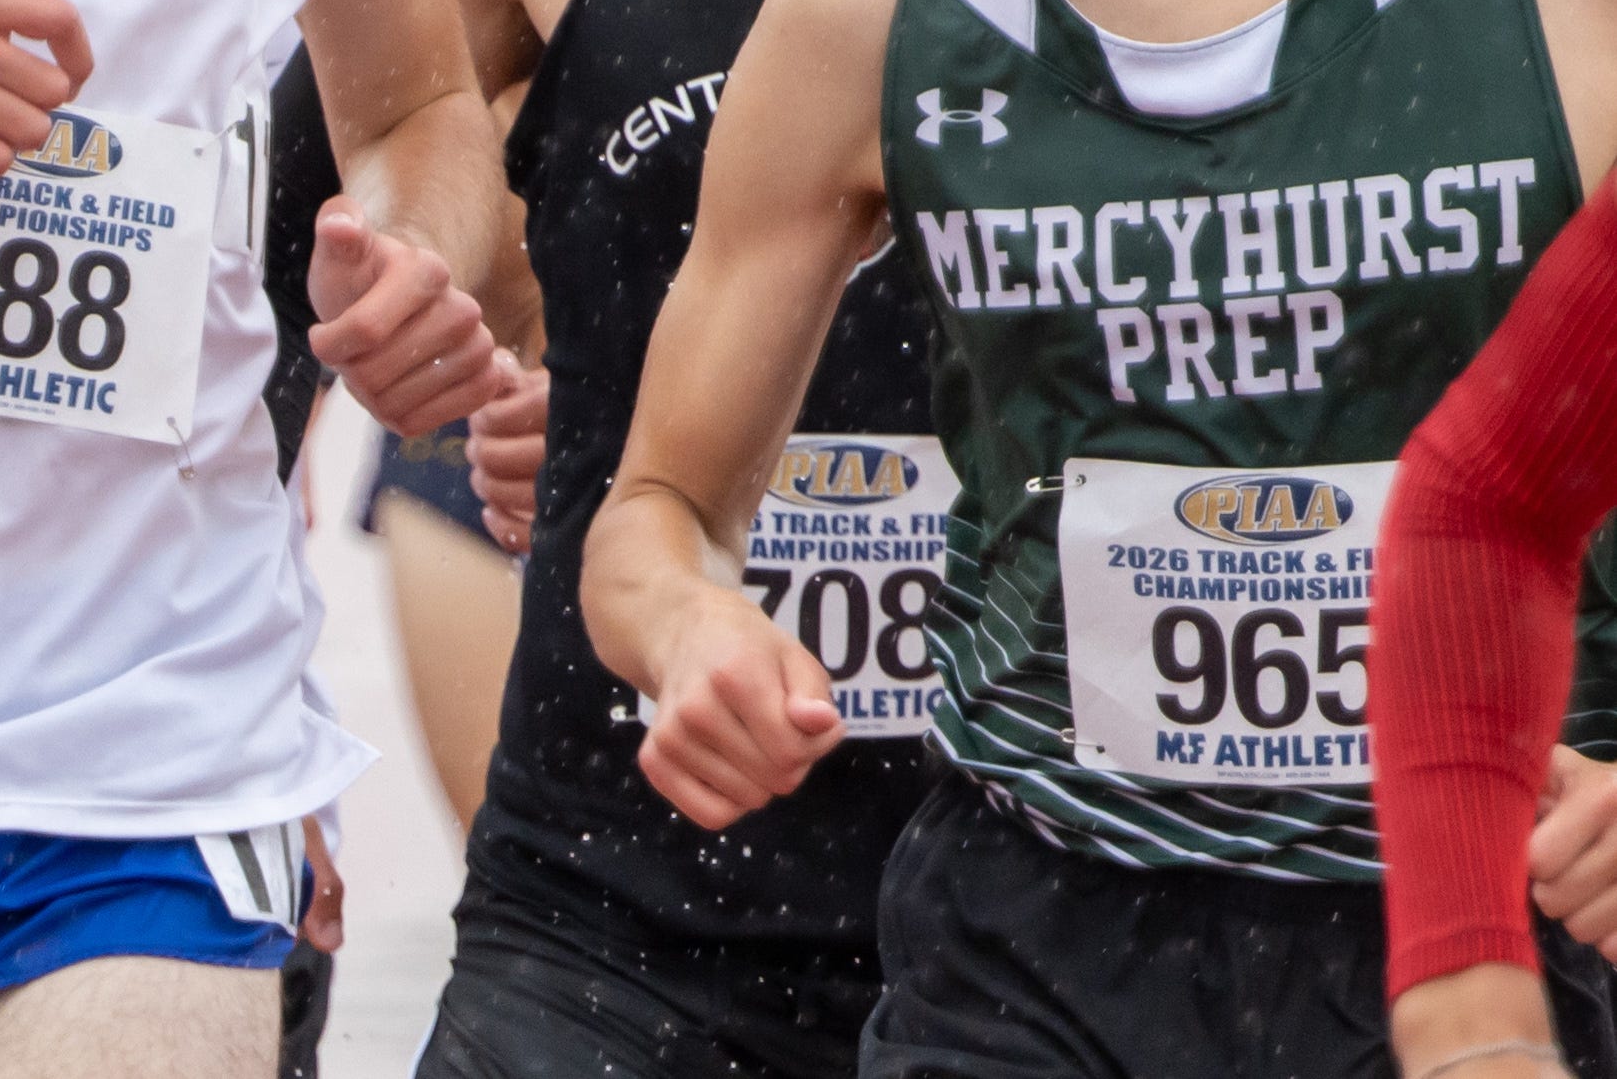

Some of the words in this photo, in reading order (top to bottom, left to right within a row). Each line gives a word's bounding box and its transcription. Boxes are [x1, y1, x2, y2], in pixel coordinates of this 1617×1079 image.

[605, 71, 726, 176] CENT
[85, 193, 101, 215] &
[107, 194, 176, 229] FIELD
[915, 158, 1536, 310] MERCYHURST
[1097, 289, 1345, 402] PREP
[776, 449, 909, 497] PIAA
[771, 512, 873, 536] TRACK
[881, 517, 902, 536] &
[1200, 483, 1343, 533] PIAA
[750, 537, 945, 562] AMPIONSHIP
[1107, 544, 1190, 573] 2026
[1197, 549, 1307, 575] TRACK
[1315, 552, 1338, 573] &
[742, 567, 944, 682] 708
[1152, 605, 1371, 729] 965
[1156, 730, 1206, 765] MF
[1213, 732, 1371, 768] ATHLETI
